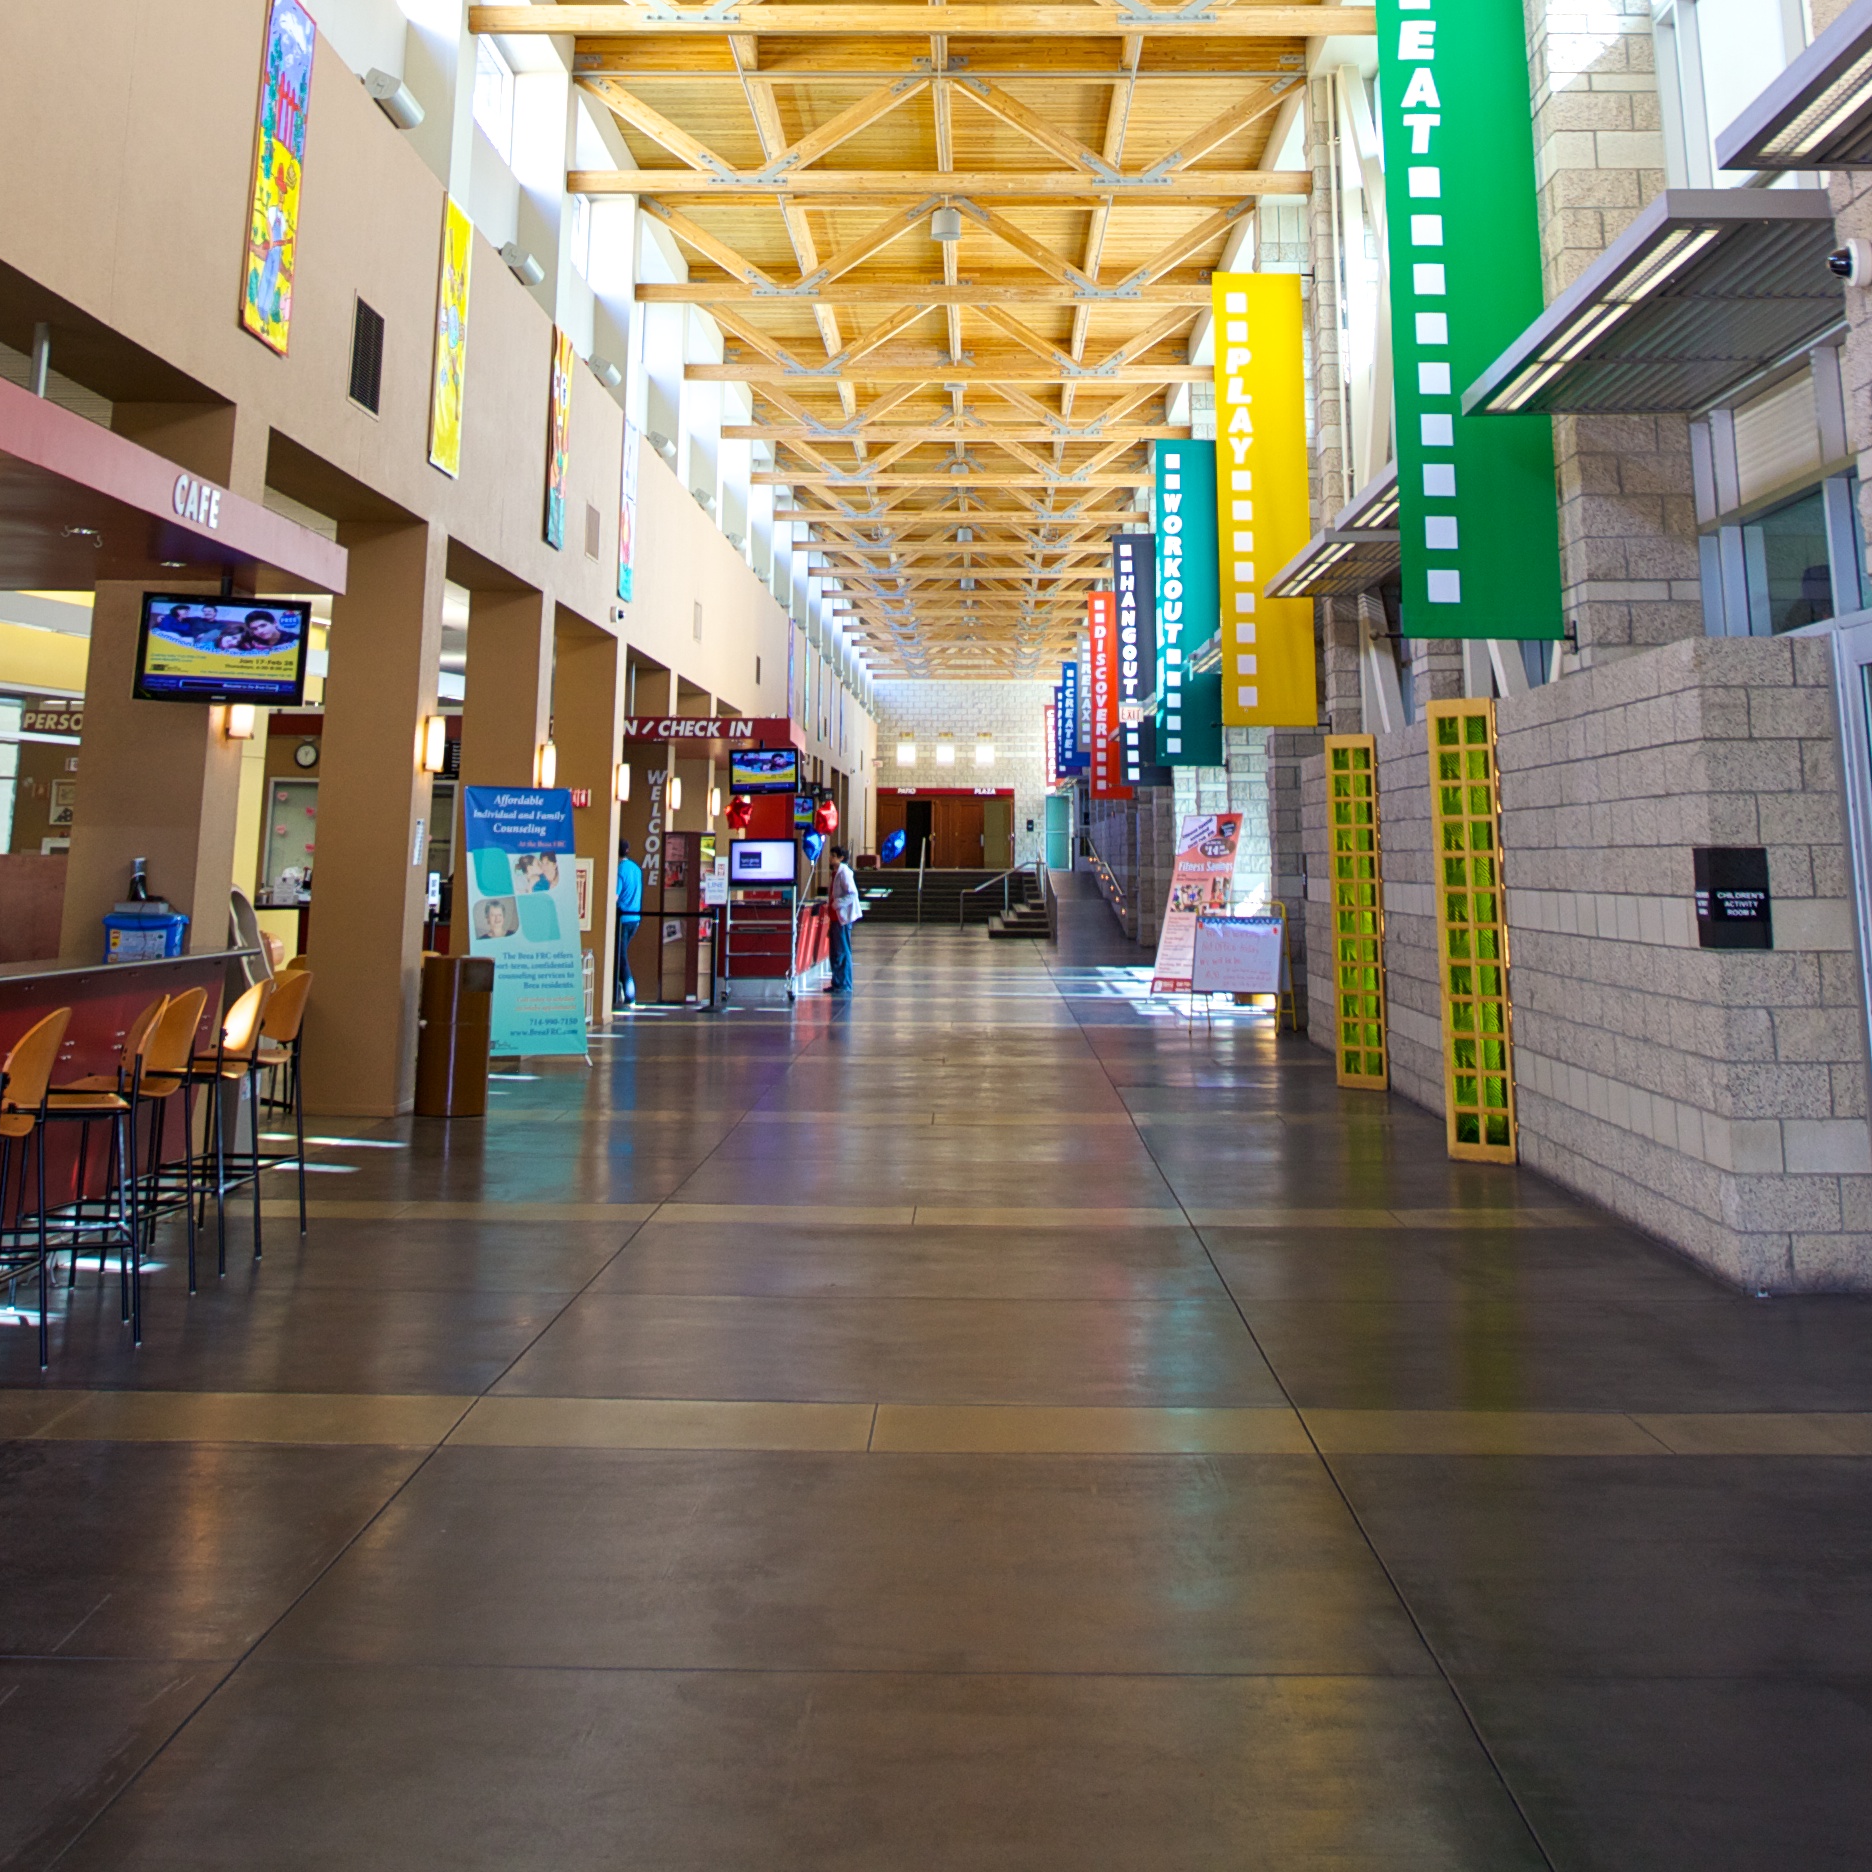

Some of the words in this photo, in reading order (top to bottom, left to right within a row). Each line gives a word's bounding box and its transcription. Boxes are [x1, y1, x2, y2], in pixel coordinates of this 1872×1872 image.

[1397, 19, 1441, 154] EAT
[1226, 347, 1254, 465] PLAY
[173, 474, 221, 529] CAFE
[1163, 493, 1183, 644] WORKOUT
[1120, 575, 1137, 695] HANGOUT
[1094, 625, 1107, 736] DISCOVER
[1081, 665, 1091, 721] RELAX
[1064, 688, 1076, 749] CREATE
[1121, 708, 1142, 721] EXIT
[658, 720, 722, 737] CHECK
[729, 720, 754, 737] IN
[897, 787, 917, 795] PATIO
[974, 787, 996, 795] PLAZA
[494, 794, 544, 807] Affordable
[473, 809, 517, 819] Individual
[518, 811, 533, 820] and
[536, 811, 566, 822] Family
[493, 823, 546, 836] Counseling
[642, 769, 668, 886] WELCOME
[1179, 862, 1204, 872] Fitness
[1716, 891, 1765, 899] CHILDREN'S
[1724, 900, 1758, 908] ACTIVITY
[1750, 908, 1757, 916] A
[553, 951, 573, 960] offers
[531, 961, 574, 970] confidential
[498, 972, 536, 980] counseling
[567, 971, 574, 979] to
